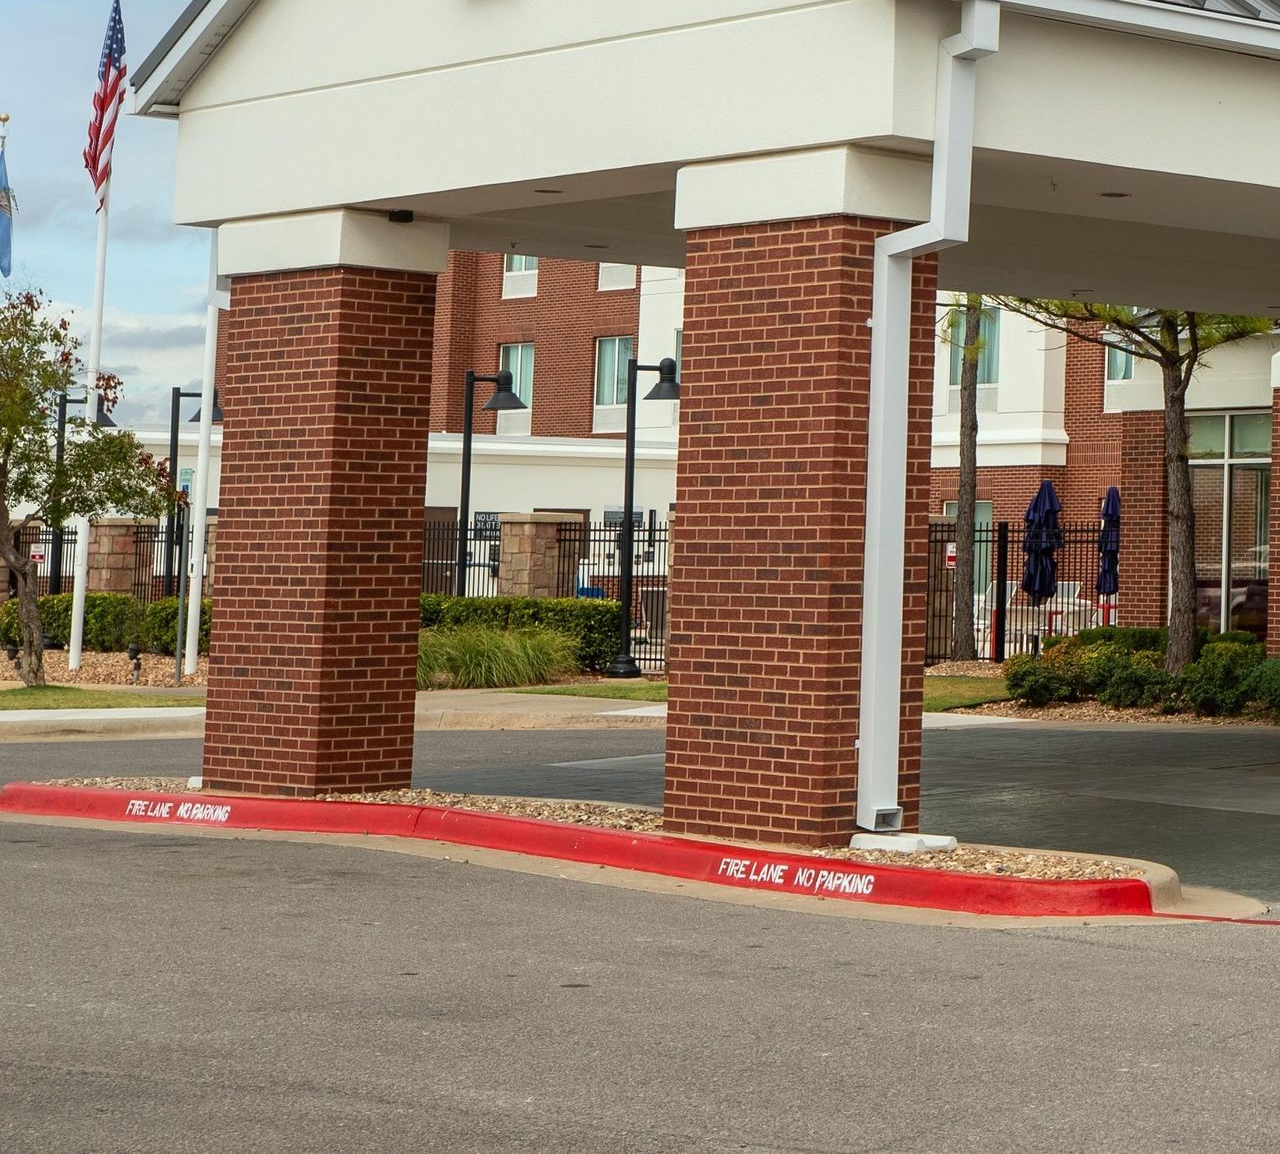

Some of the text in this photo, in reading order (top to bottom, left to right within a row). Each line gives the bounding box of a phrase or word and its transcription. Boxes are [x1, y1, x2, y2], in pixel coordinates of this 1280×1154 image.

[125, 799, 231, 822] FIRE LANE NO PARKING
[717, 857, 751, 879] FIRE
[748, 862, 789, 884] LANE
[793, 867, 815, 887] NO
